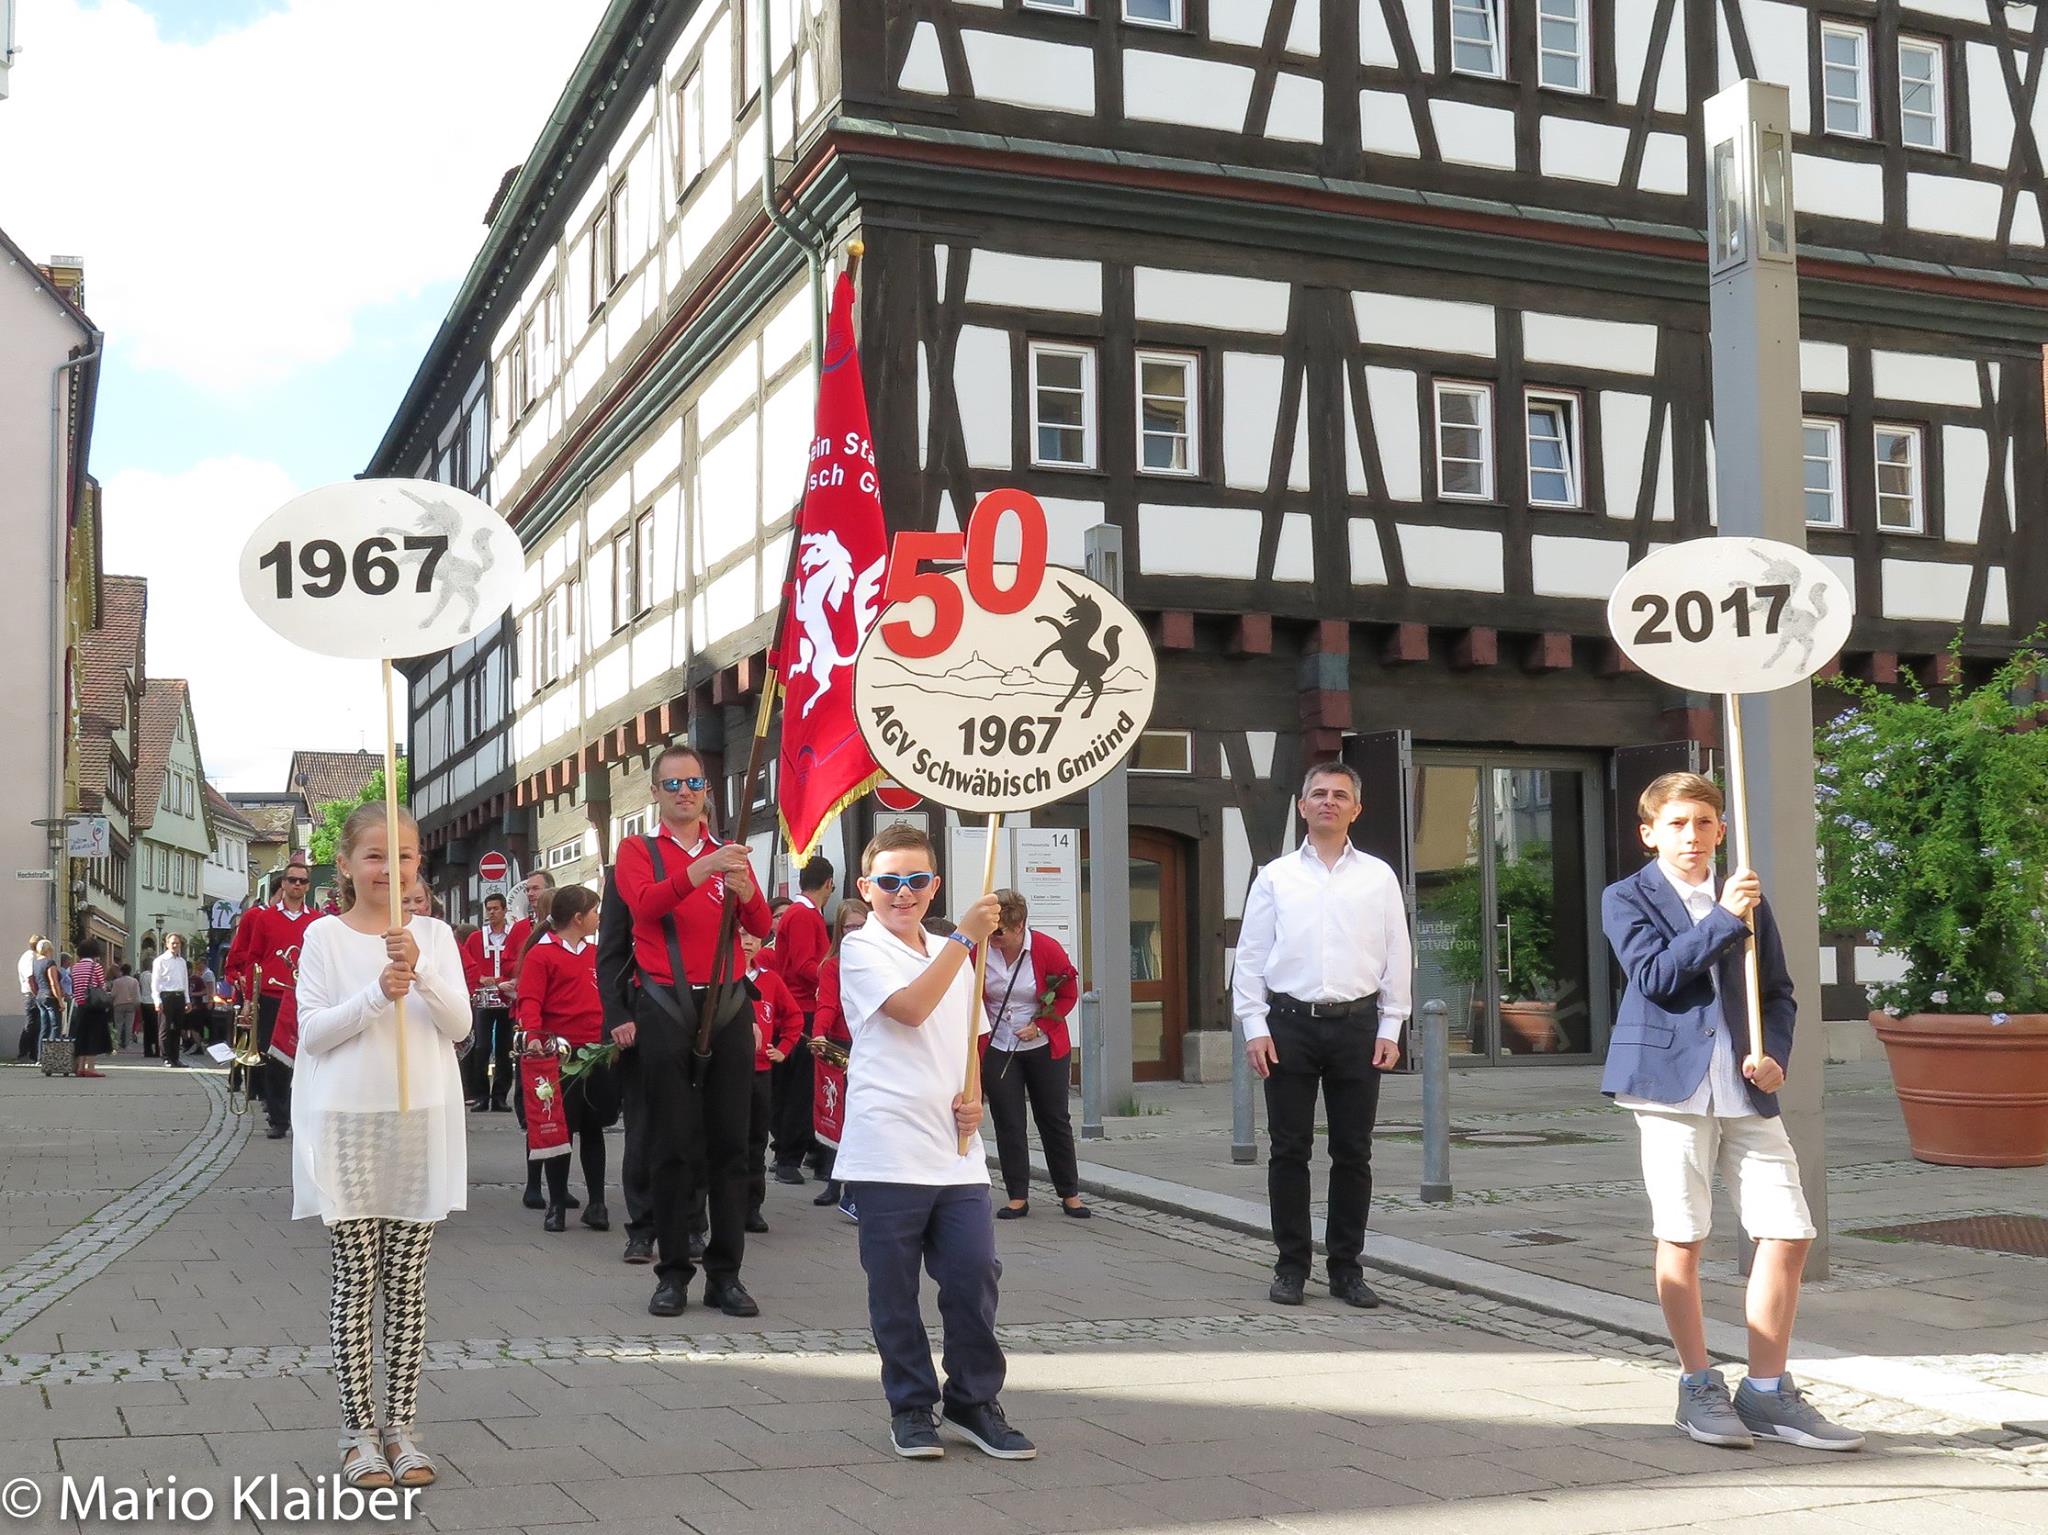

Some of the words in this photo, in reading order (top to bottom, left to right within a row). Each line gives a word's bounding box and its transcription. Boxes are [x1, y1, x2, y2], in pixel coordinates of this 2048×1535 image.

[259, 534, 449, 600] 1967
[880, 488, 1048, 659] 50
[1631, 583, 1791, 646] 2017
[871, 704, 917, 757] AGV
[912, 747, 1051, 798] Schwäbisch
[1057, 710, 1135, 784] Gmünd
[958, 714, 1062, 757] 1967
[1051, 833, 1069, 848] 14
